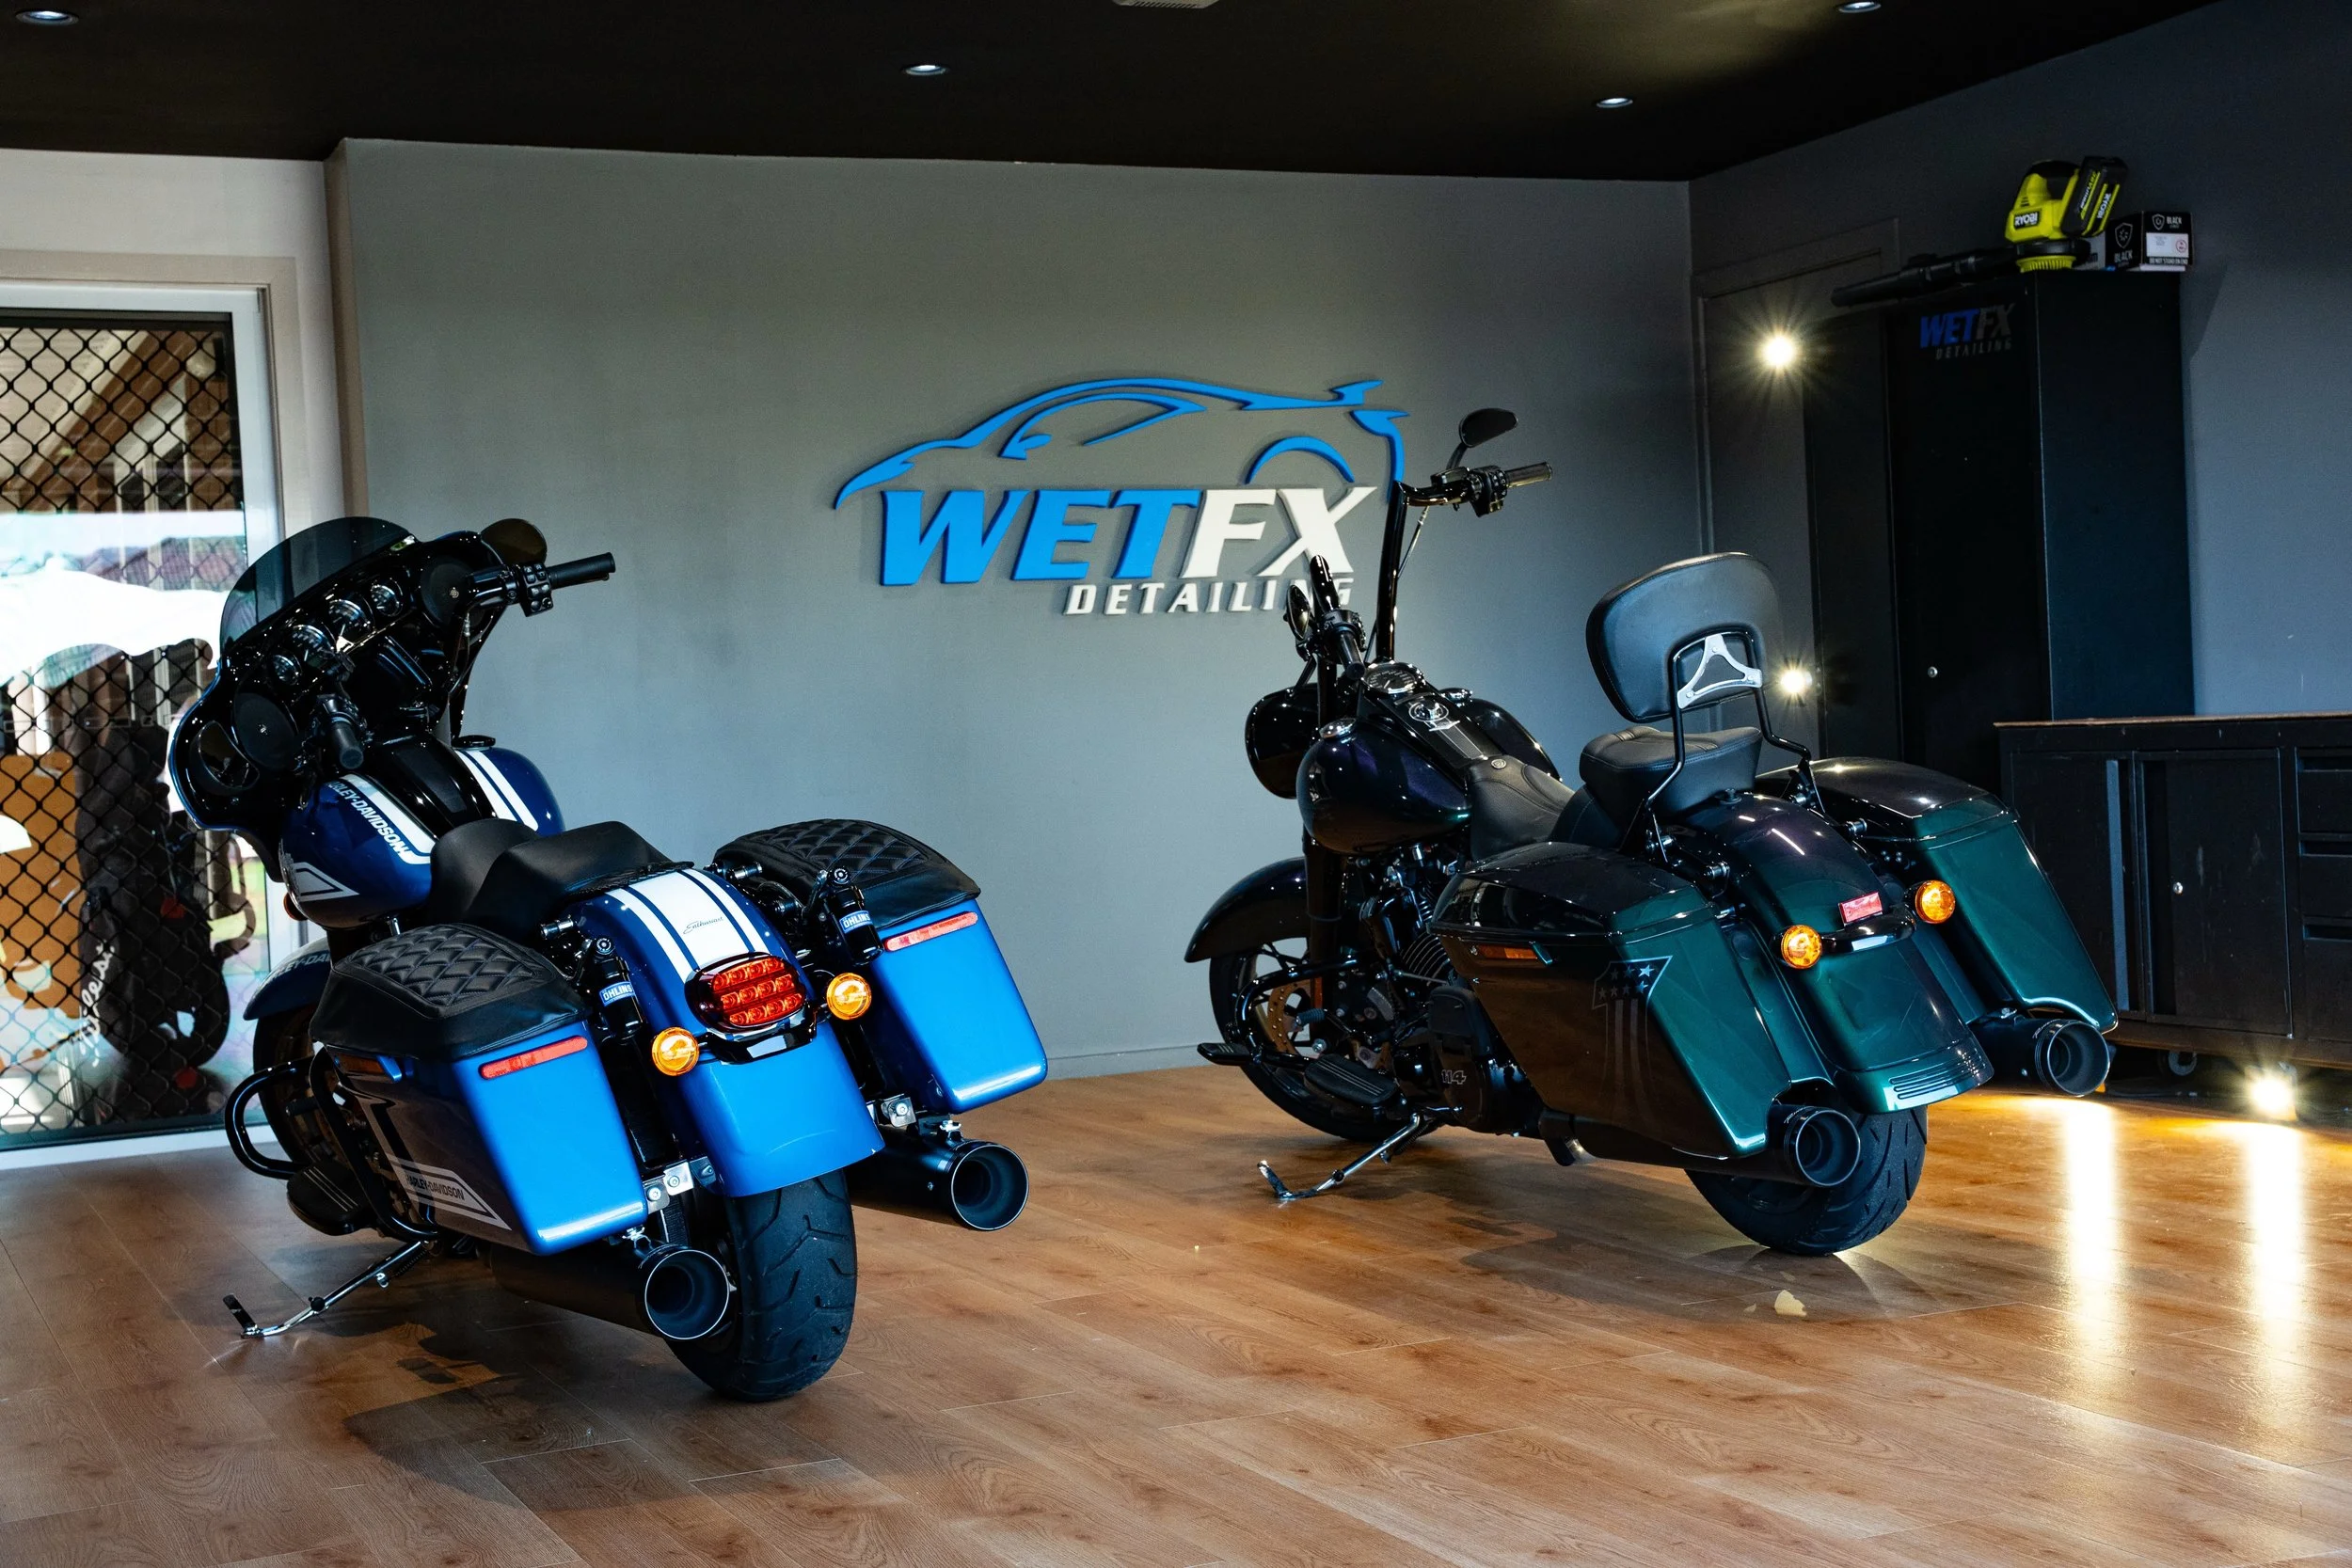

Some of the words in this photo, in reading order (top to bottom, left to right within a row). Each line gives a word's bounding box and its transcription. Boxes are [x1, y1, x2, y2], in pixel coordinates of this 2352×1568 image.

[2014, 212, 2038, 227] RYOBI
[2114, 249, 2133, 263] BLACK
[1920, 303, 2016, 349] WETFX
[1935, 337, 2012, 361] DETAILING
[881, 486, 1377, 585] WETFX
[327, 780, 410, 854] ARLEY-DAVIDSON
[602, 984, 633, 1001] ÖHLINS
[1441, 1069, 1467, 1085] 114
